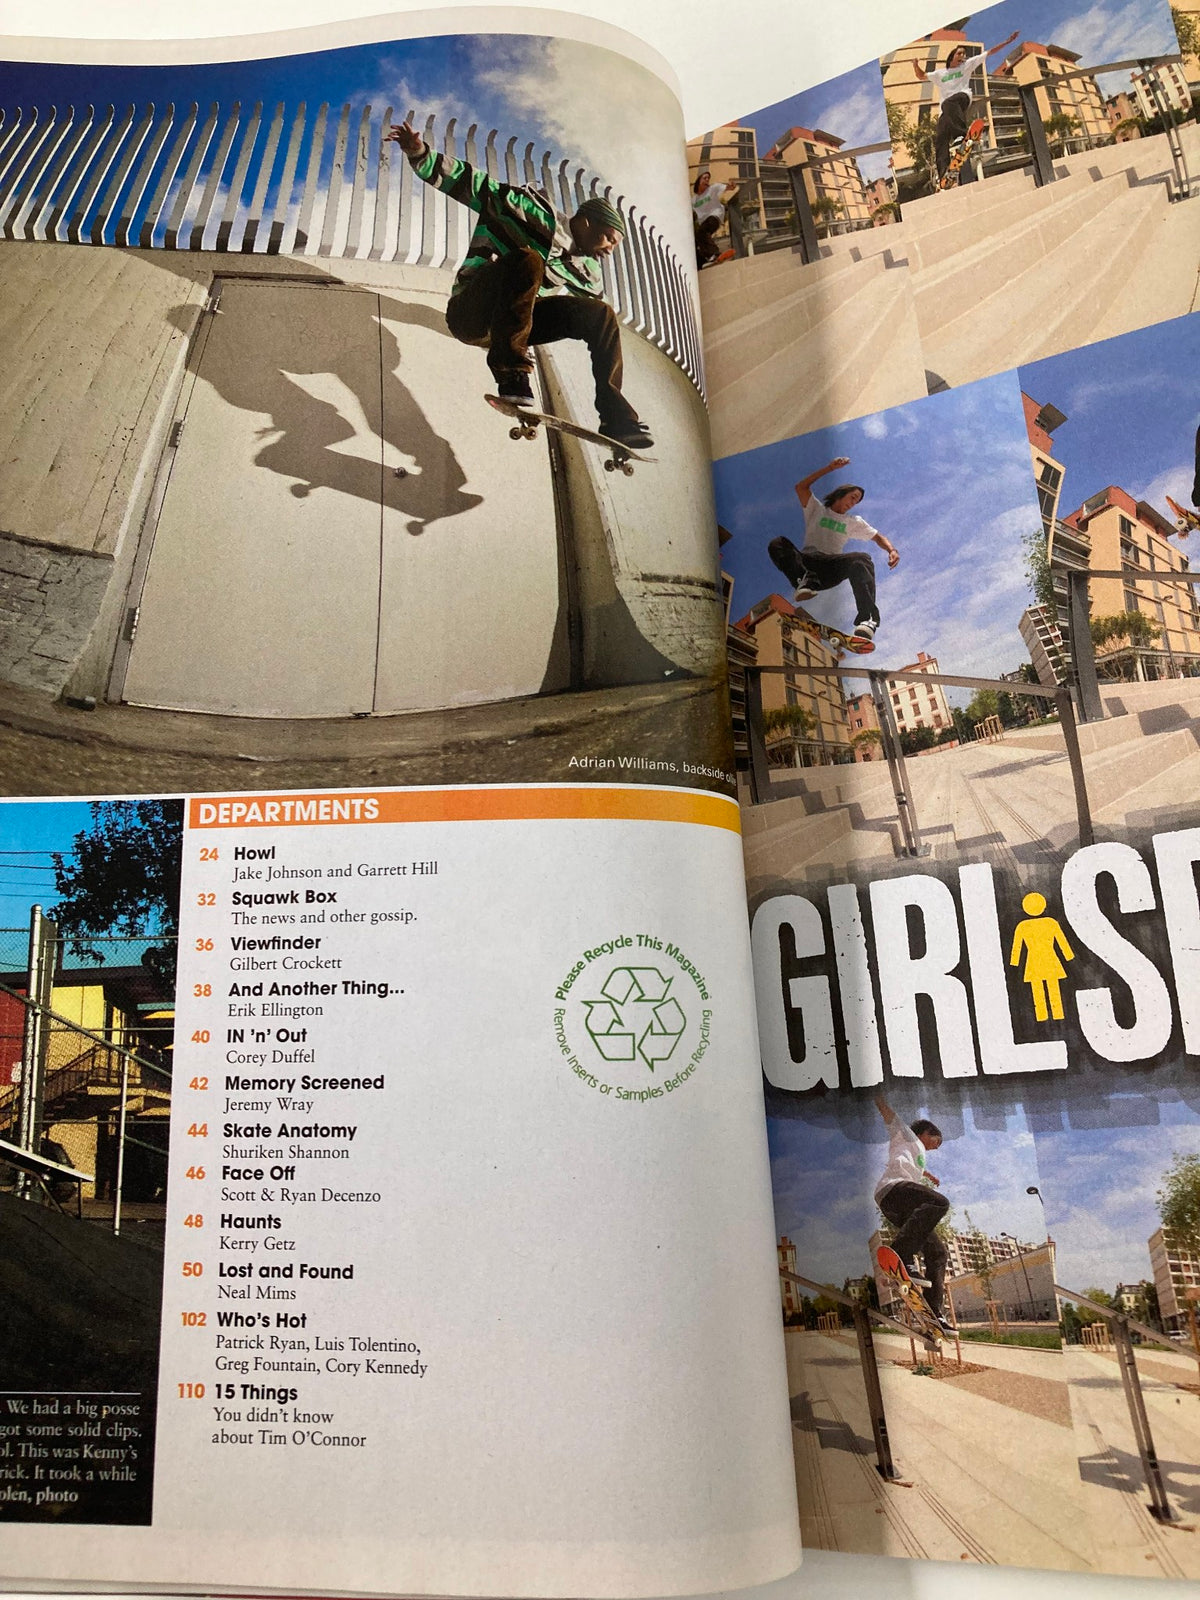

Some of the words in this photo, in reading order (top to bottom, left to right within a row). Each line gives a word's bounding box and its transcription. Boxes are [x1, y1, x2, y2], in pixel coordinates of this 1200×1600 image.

[569, 756, 615, 768] Adrian
[618, 756, 679, 773] Williams,
[683, 762, 724, 780] backside
[199, 798, 379, 824] DEPARTMENTS
[200, 848, 219, 861] 24
[234, 846, 275, 860] Howl
[232, 867, 262, 883] Jake
[266, 865, 322, 881] Johnson
[327, 864, 352, 878] and
[357, 864, 407, 877] Garrett
[411, 862, 438, 875] Hill
[197, 893, 216, 906] 32
[232, 890, 299, 908] Squawk
[306, 890, 337, 903] Box
[232, 912, 258, 925] The
[262, 913, 295, 924] news
[300, 912, 325, 924] and
[330, 910, 366, 923] other
[370, 909, 417, 925] gossip.
[195, 938, 214, 951] 36
[231, 936, 321, 951] Viewfinder
[229, 957, 277, 971] Gilbert
[282, 956, 342, 970] Crockett
[555, 961, 585, 1000] Please
[583, 935, 632, 962] Recycle
[636, 934, 663, 950] This
[665, 943, 710, 1000] Magazine
[751, 861, 1068, 1091] GIRL
[194, 984, 212, 997] 38
[229, 982, 263, 997] And
[269, 982, 337, 996] Another
[342, 980, 405, 999] Thing...
[228, 1003, 256, 1017] Erik
[261, 1003, 323, 1020] Ellington
[191, 1030, 210, 1044] 40
[227, 1029, 244, 1043] IN
[276, 1028, 307, 1043] Out
[226, 1050, 267, 1067] Corey
[271, 1049, 315, 1063] Duffel
[554, 1008, 571, 1055] Remove
[567, 1055, 598, 1088] Inserts
[600, 1084, 613, 1095] or
[615, 1087, 664, 1102] Samples
[663, 1062, 696, 1092] Before
[691, 1009, 712, 1063] Recycling
[189, 1077, 208, 1090] 42
[225, 1076, 296, 1094] Memory
[301, 1075, 384, 1089] Screened
[223, 1097, 271, 1114] Jeremy
[276, 1097, 313, 1113] Wray
[187, 1123, 208, 1137] 44
[223, 1123, 271, 1138] Skate
[277, 1123, 357, 1141] Anatomy
[223, 1146, 283, 1159] Shuriken
[288, 1145, 349, 1159] Shannon
[186, 1166, 205, 1180] 46
[222, 1166, 264, 1181] Face
[270, 1166, 295, 1180] Off
[220, 1188, 256, 1202] Scott
[261, 1189, 274, 1202] &
[280, 1189, 316, 1205] Ryan
[321, 1188, 380, 1202] Decenzo
[184, 1214, 203, 1228] 48
[220, 1214, 281, 1229] Haunts
[219, 1236, 258, 1253] Kerry
[264, 1237, 296, 1251] Getz
[182, 1263, 203, 1277] 50
[219, 1263, 253, 1278] Lost
[259, 1263, 293, 1278] and
[300, 1264, 354, 1279] Found
[217, 1284, 251, 1299] Neal
[255, 1286, 296, 1299] Mims
[181, 1312, 207, 1327] 102
[276, 1313, 307, 1328] Hot
[216, 1335, 264, 1350] Patrick
[269, 1336, 310, 1353] Ryan,
[315, 1337, 345, 1351] Luis
[349, 1338, 420, 1354] Tolentino,
[215, 1357, 249, 1374] Greg
[254, 1357, 320, 1374] Fountain,
[325, 1359, 360, 1376] Cory
[365, 1359, 428, 1377] Kennedy
[178, 1383, 205, 1398] 110
[215, 1384, 235, 1399] 15
[241, 1384, 297, 1404] Things
[7, 1400, 29, 1414] We
[33, 1400, 59, 1414] had
[63, 1405, 71, 1414] a
[76, 1400, 97, 1418] big
[102, 1405, 140, 1419] posse
[213, 1407, 241, 1422] You
[293, 1408, 334, 1423] know
[0, 1424, 20, 1438] got
[26, 1425, 62, 1436] some
[68, 1422, 100, 1436] solid
[106, 1422, 142, 1440] clips.
[211, 1429, 253, 1444] about
[258, 1430, 287, 1445] Tim
[18, 1442, 48, 1458] This
[52, 1448, 79, 1458] was
[34, 1465, 44, 1479] It
[49, 1465, 81, 1479] took
[86, 1471, 93, 1480] a
[99, 1466, 136, 1481] while
[36, 1486, 78, 1505] photo
